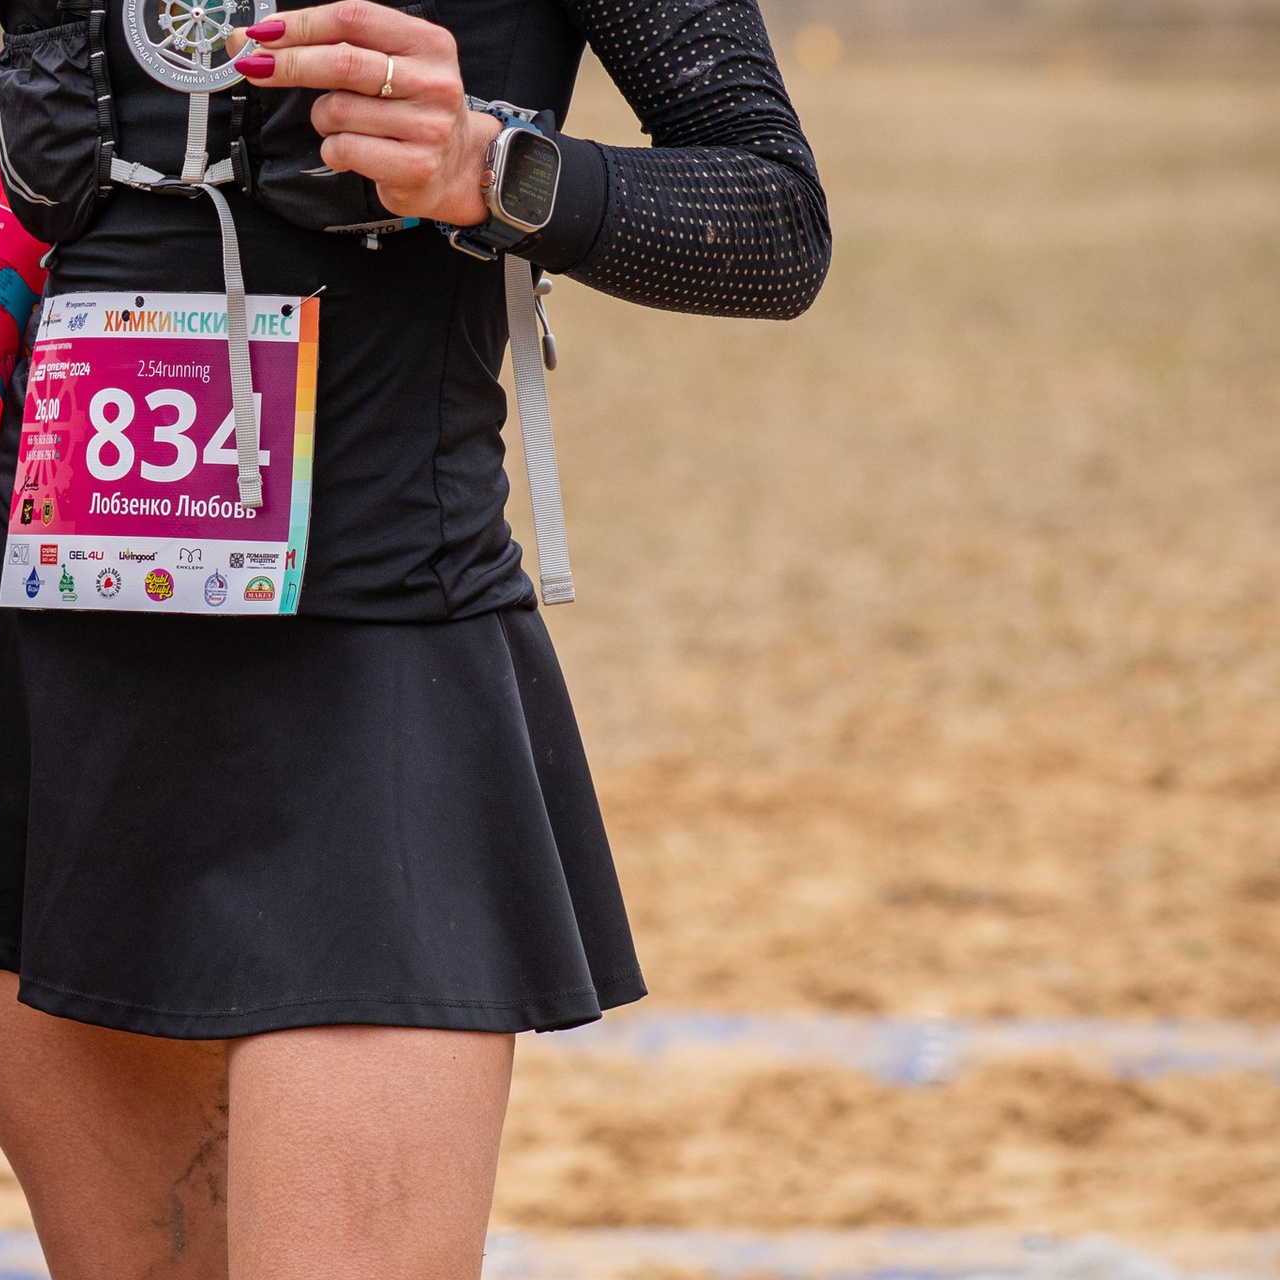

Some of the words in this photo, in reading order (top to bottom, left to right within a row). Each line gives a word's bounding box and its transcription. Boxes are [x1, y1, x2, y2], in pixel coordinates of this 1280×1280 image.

[170, 71, 206, 84] ХИМКИ
[103, 310, 228, 334] ХИМКИНСКИ
[251, 313, 293, 336] ЛЕС
[47, 362, 70, 372] DREAM
[70, 361, 91, 376] 2024
[49, 371, 67, 380] TRAIL
[137, 360, 211, 383] 2.54running
[35, 398, 60, 424] 26,00
[86, 387, 270, 482] 834
[89, 492, 172, 516] Лобзенко
[175, 495, 258, 519] Любовь
[69, 550, 104, 560] GEL4U
[119, 549, 156, 563] Livingood
